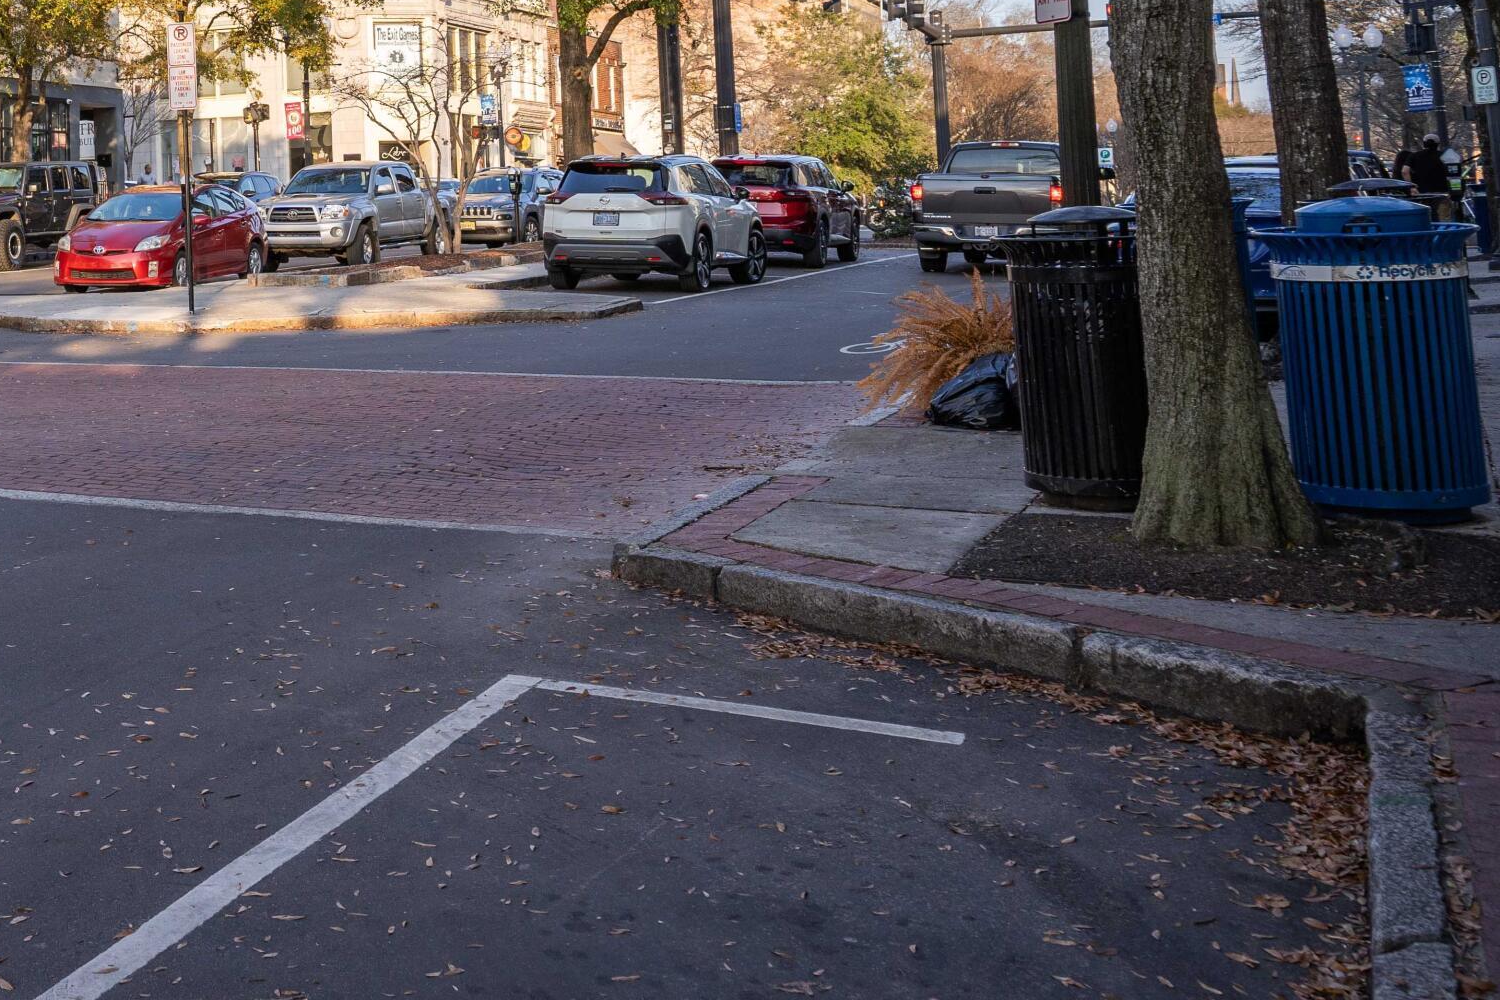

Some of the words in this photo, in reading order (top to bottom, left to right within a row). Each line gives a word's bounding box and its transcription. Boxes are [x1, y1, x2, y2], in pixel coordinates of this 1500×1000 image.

[377, 27, 387, 40] The
[387, 27, 398, 40] Exit
[287, 125, 301, 136] 100
[1379, 263, 1437, 279] Recycle
